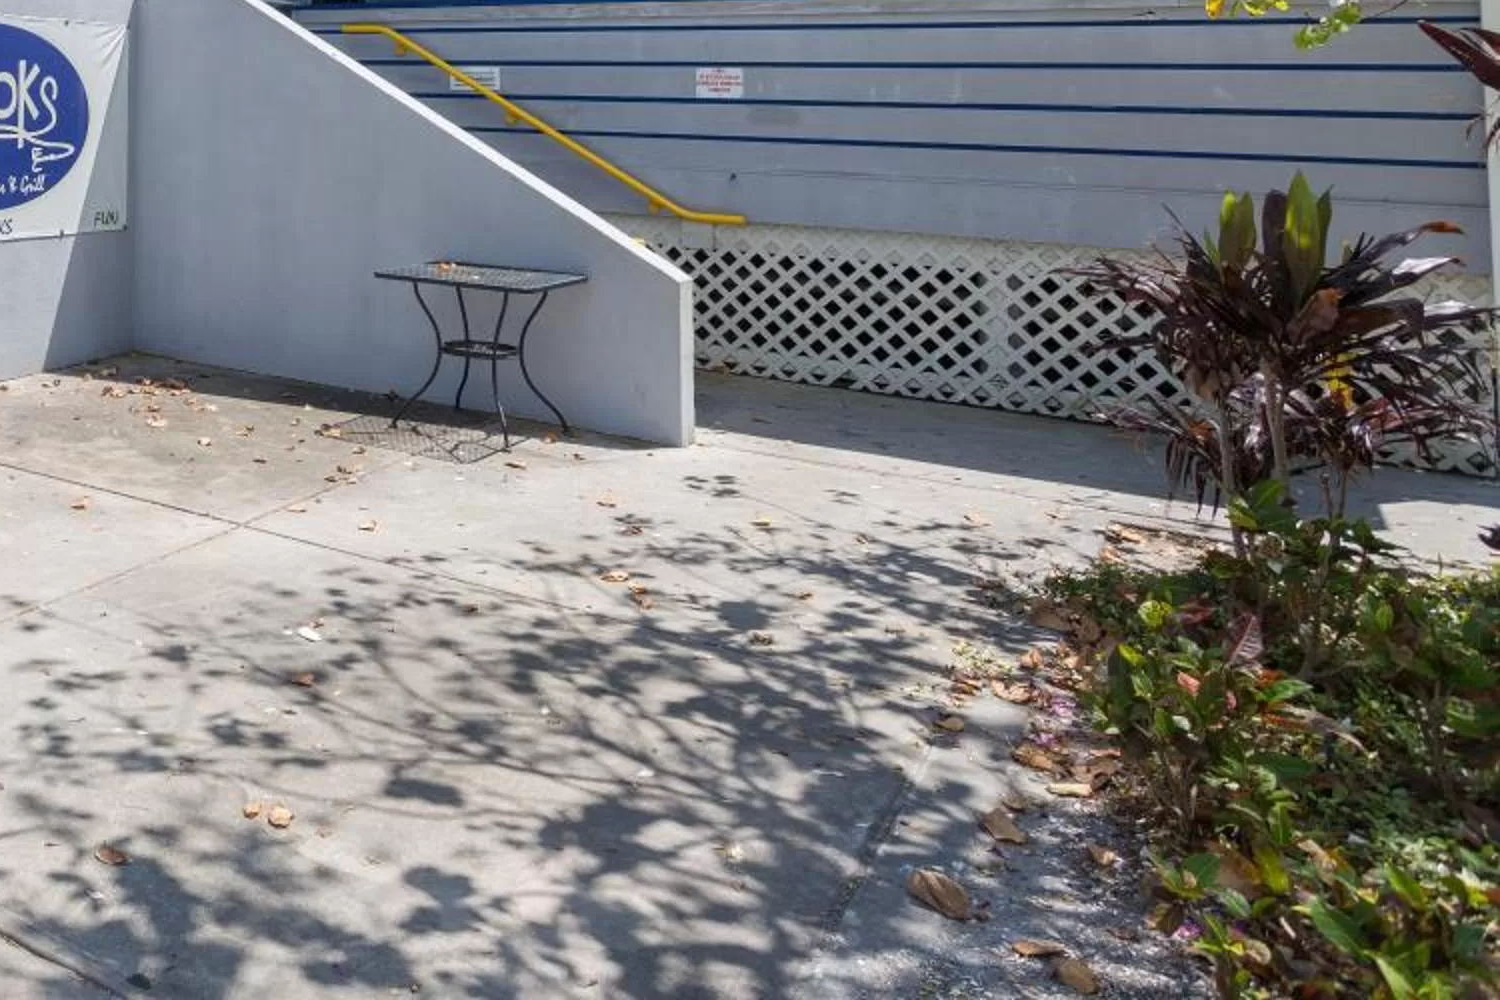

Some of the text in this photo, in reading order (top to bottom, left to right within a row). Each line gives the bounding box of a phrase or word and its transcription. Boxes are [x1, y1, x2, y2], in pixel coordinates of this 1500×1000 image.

[8, 175, 18, 193] &
[20, 173, 45, 196] Grill
[93, 210, 119, 227] FUN
